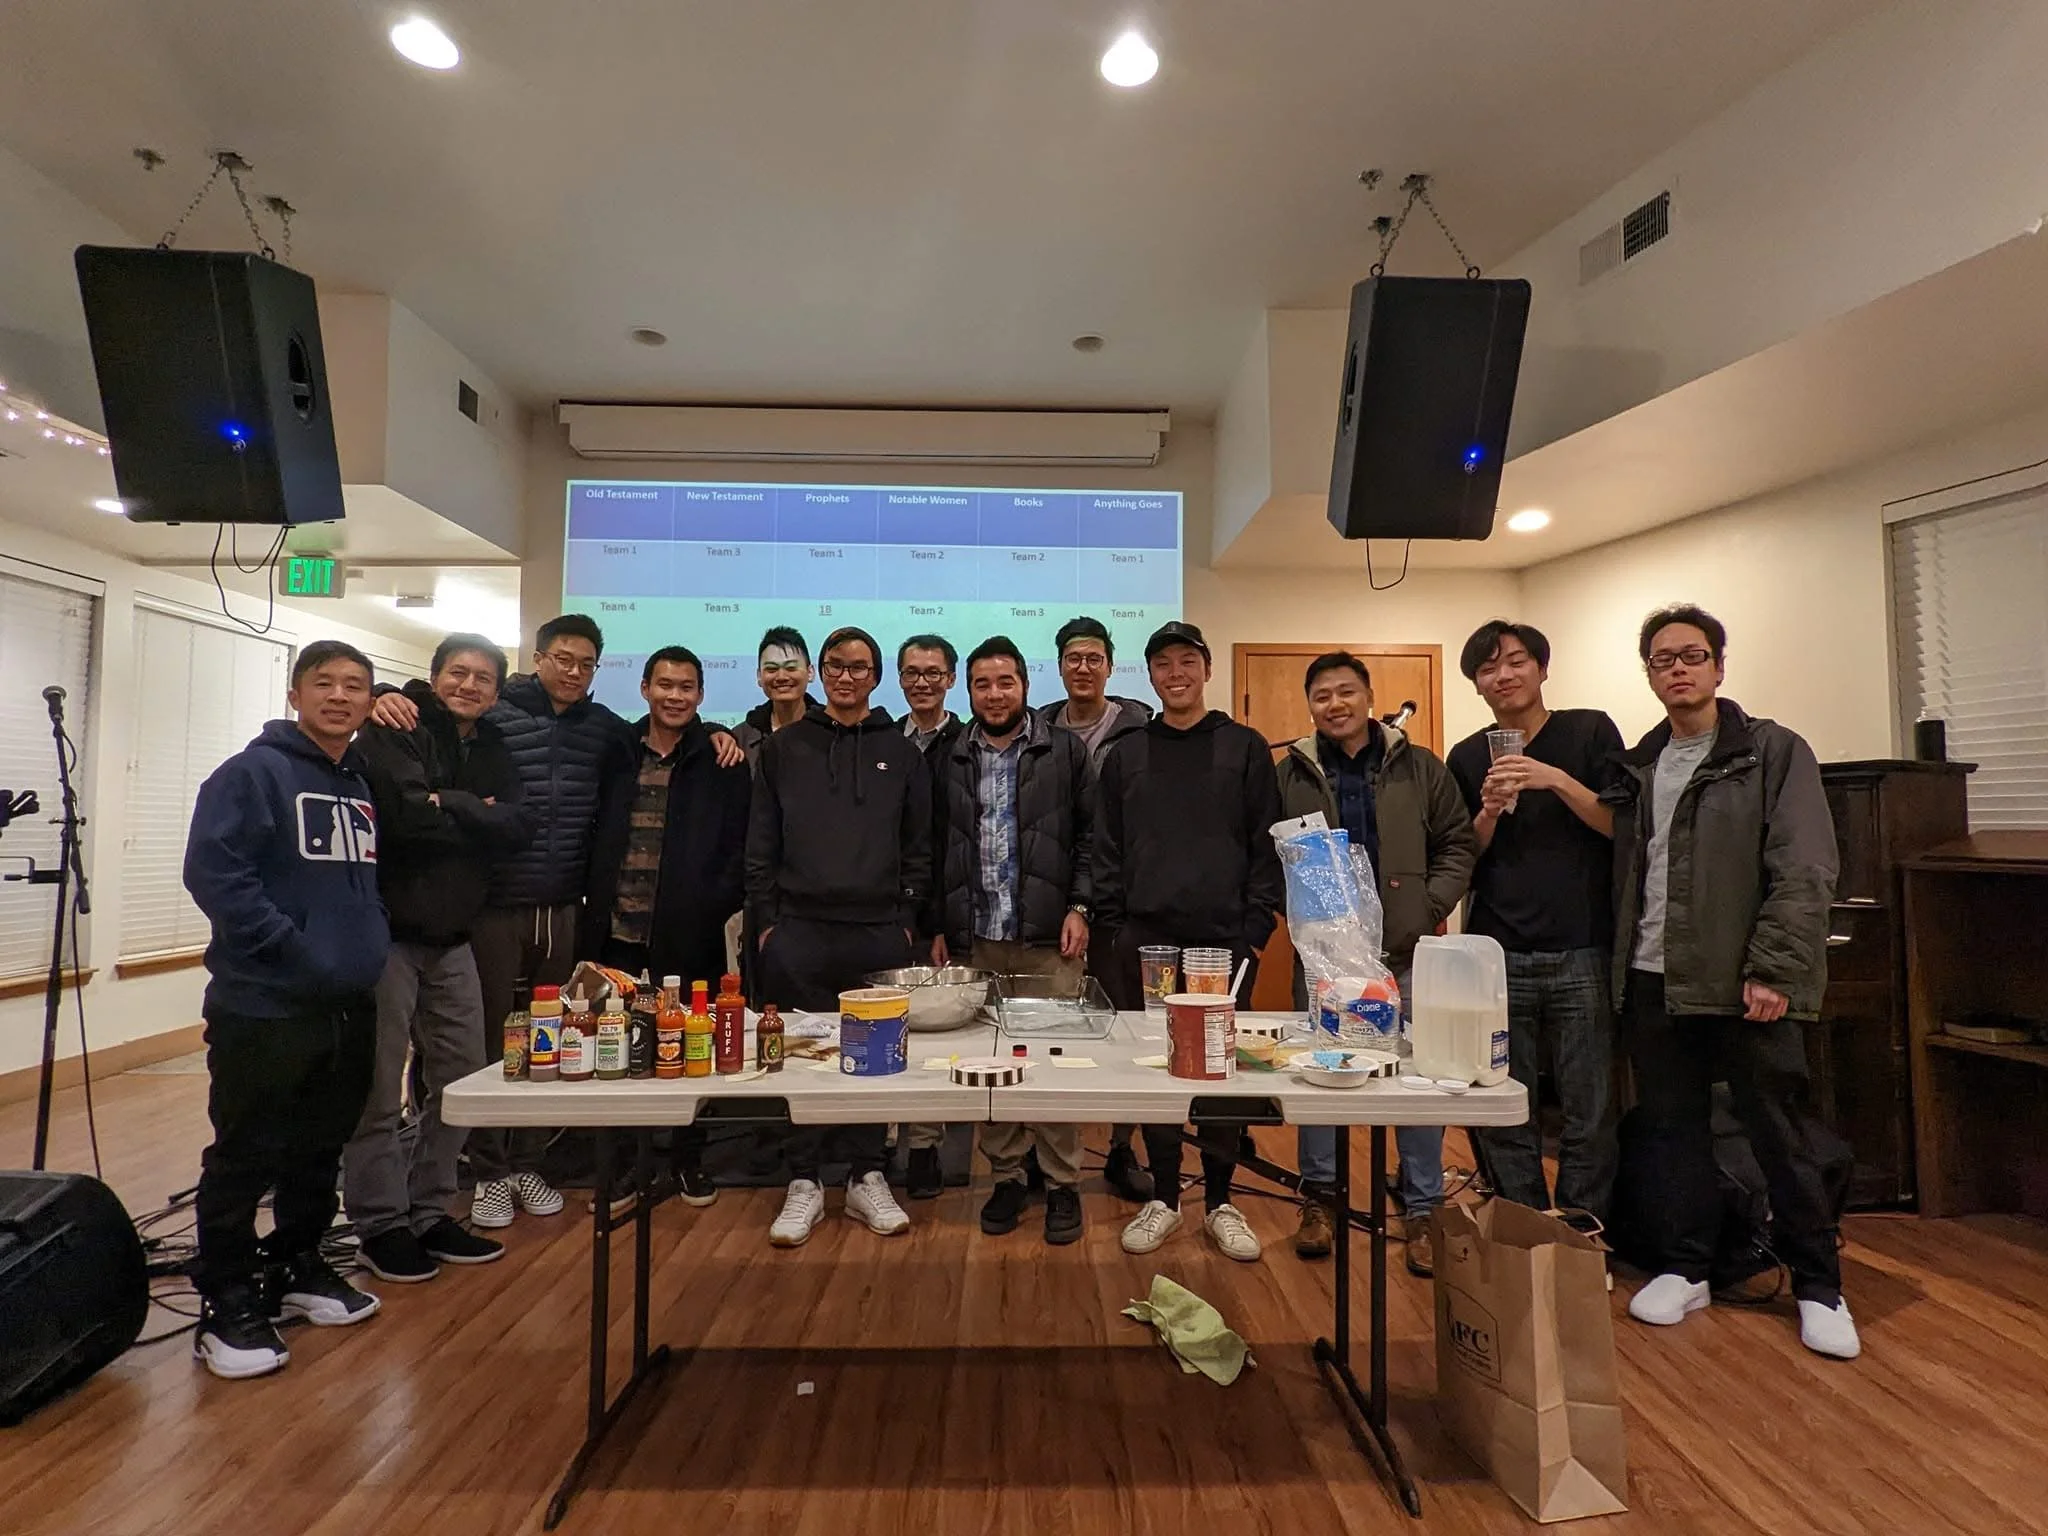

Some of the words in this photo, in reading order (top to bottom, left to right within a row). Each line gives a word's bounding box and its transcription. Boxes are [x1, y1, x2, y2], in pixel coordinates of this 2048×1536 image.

[586, 489, 602, 498] Old
[605, 489, 659, 500] Testament
[687, 491, 709, 500] New
[711, 491, 764, 501] Testament
[805, 493, 850, 504] Prophets
[889, 494, 927, 504] Notable
[929, 495, 968, 505] Women
[1014, 497, 1043, 507] Books
[1094, 499, 1137, 510] Anything
[1138, 499, 1163, 509] Goes
[603, 545, 630, 554] Team
[706, 547, 733, 556] Team
[734, 547, 741, 556] 3
[809, 548, 835, 558] Team
[910, 550, 936, 559] Team
[938, 550, 945, 559] 2
[1011, 552, 1037, 561] Team
[1038, 552, 1045, 561] 2
[1111, 554, 1137, 563] Team
[288, 558, 335, 594] EXIT
[600, 602, 627, 611] Team
[629, 602, 636, 611] 4
[704, 603, 731, 613] Team
[732, 603, 740, 613] 3
[909, 606, 936, 615] Team
[937, 606, 944, 615] 2
[1010, 607, 1037, 617] Team
[1038, 607, 1045, 617] 3
[1111, 609, 1137, 618] Team
[1138, 609, 1145, 618] 4
[601, 659, 625, 669] eam
[626, 659, 633, 669] 2
[703, 659, 730, 669] Team
[731, 660, 738, 669] 2
[1037, 663, 1044, 673] 2
